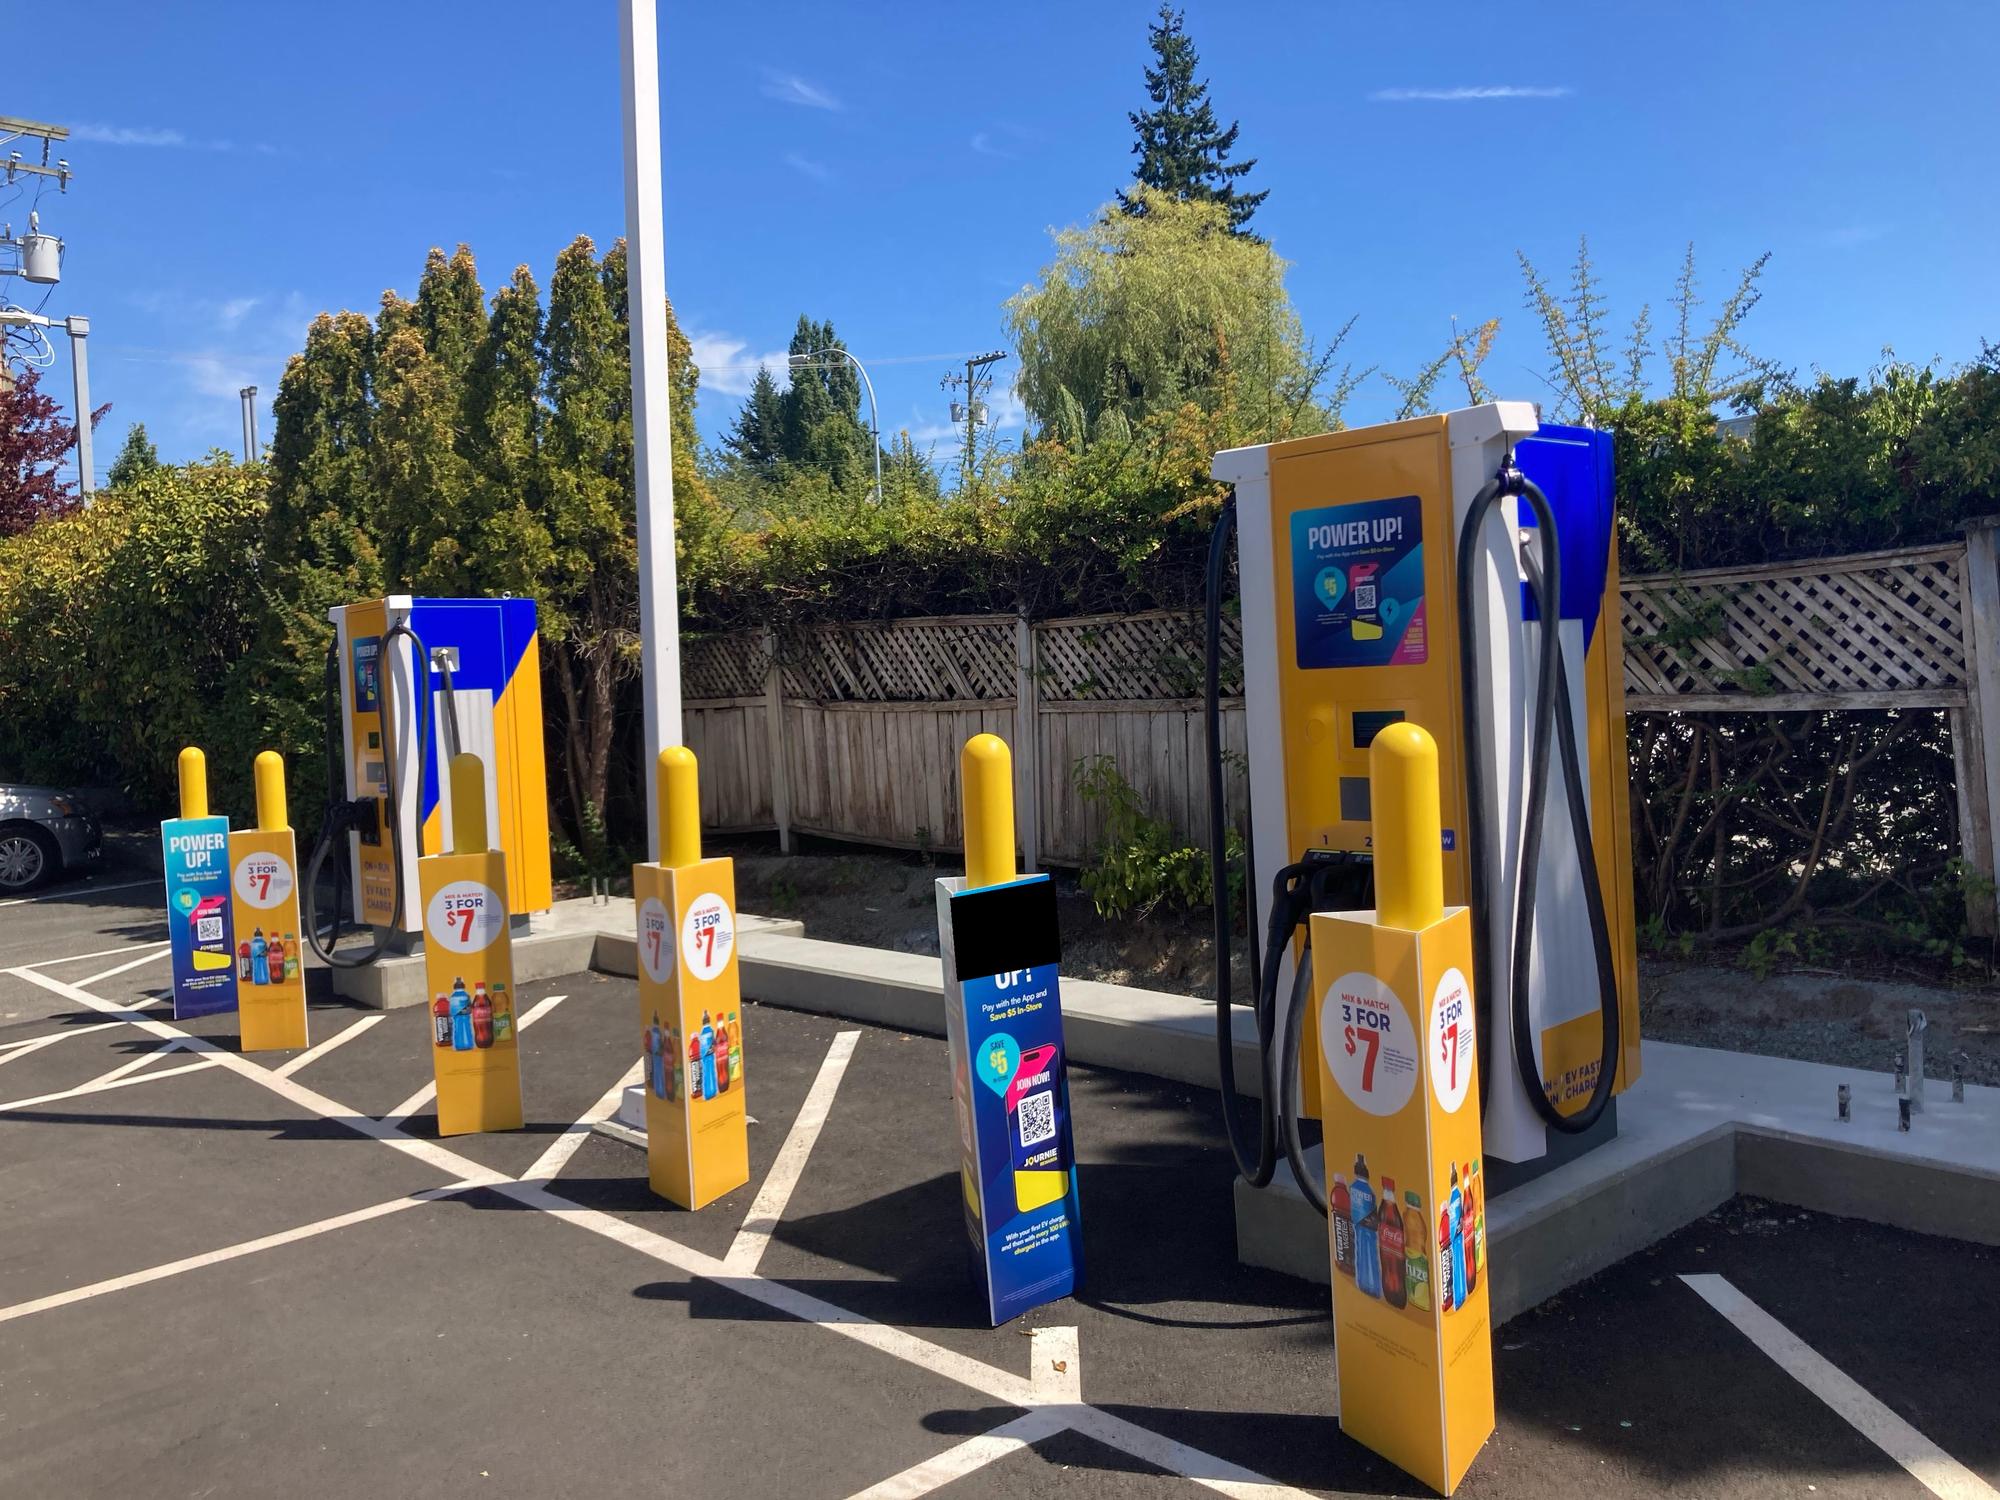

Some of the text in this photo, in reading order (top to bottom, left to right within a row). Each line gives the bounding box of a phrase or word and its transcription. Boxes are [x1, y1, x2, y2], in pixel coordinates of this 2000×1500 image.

[1308, 517, 1403, 550] POWER UP!
[170, 833, 225, 853] POWER
[1323, 834, 1328, 845] 1
[1364, 836, 1373, 847] 2
[186, 851, 211, 868] UP!
[248, 866, 254, 874] 3
[249, 874, 271, 900] $7
[376, 887, 391, 897] FAST
[368, 899, 392, 912] CHARGE
[445, 898, 483, 909] 3 FOR
[447, 909, 475, 942] $7
[651, 918, 665, 931] FOR
[694, 913, 721, 929] 3 FOR
[647, 931, 661, 970] $7
[696, 926, 715, 967] $7
[982, 988, 1048, 1012] Pay with the App and
[1341, 992, 1390, 1011] MIX & MATCH
[989, 1002, 1043, 1021] Save $5 In-Store
[1342, 1004, 1391, 1032] 3 FOR
[1440, 1000, 1462, 1029] 3 FOR
[990, 1040, 1004, 1050] SAVE
[990, 1050, 1008, 1074] $5
[1344, 1024, 1380, 1092] $7
[1441, 1022, 1458, 1091] $7
[1016, 1077, 1032, 1092] JOIN
[1032, 1070, 1051, 1086] NOW!
[1565, 1060, 1601, 1084] EV FAST
[1565, 1077, 1599, 1099] CHARG
[1024, 1147, 1058, 1167] JOURNIE
[1041, 1220, 1049, 1228] EV
